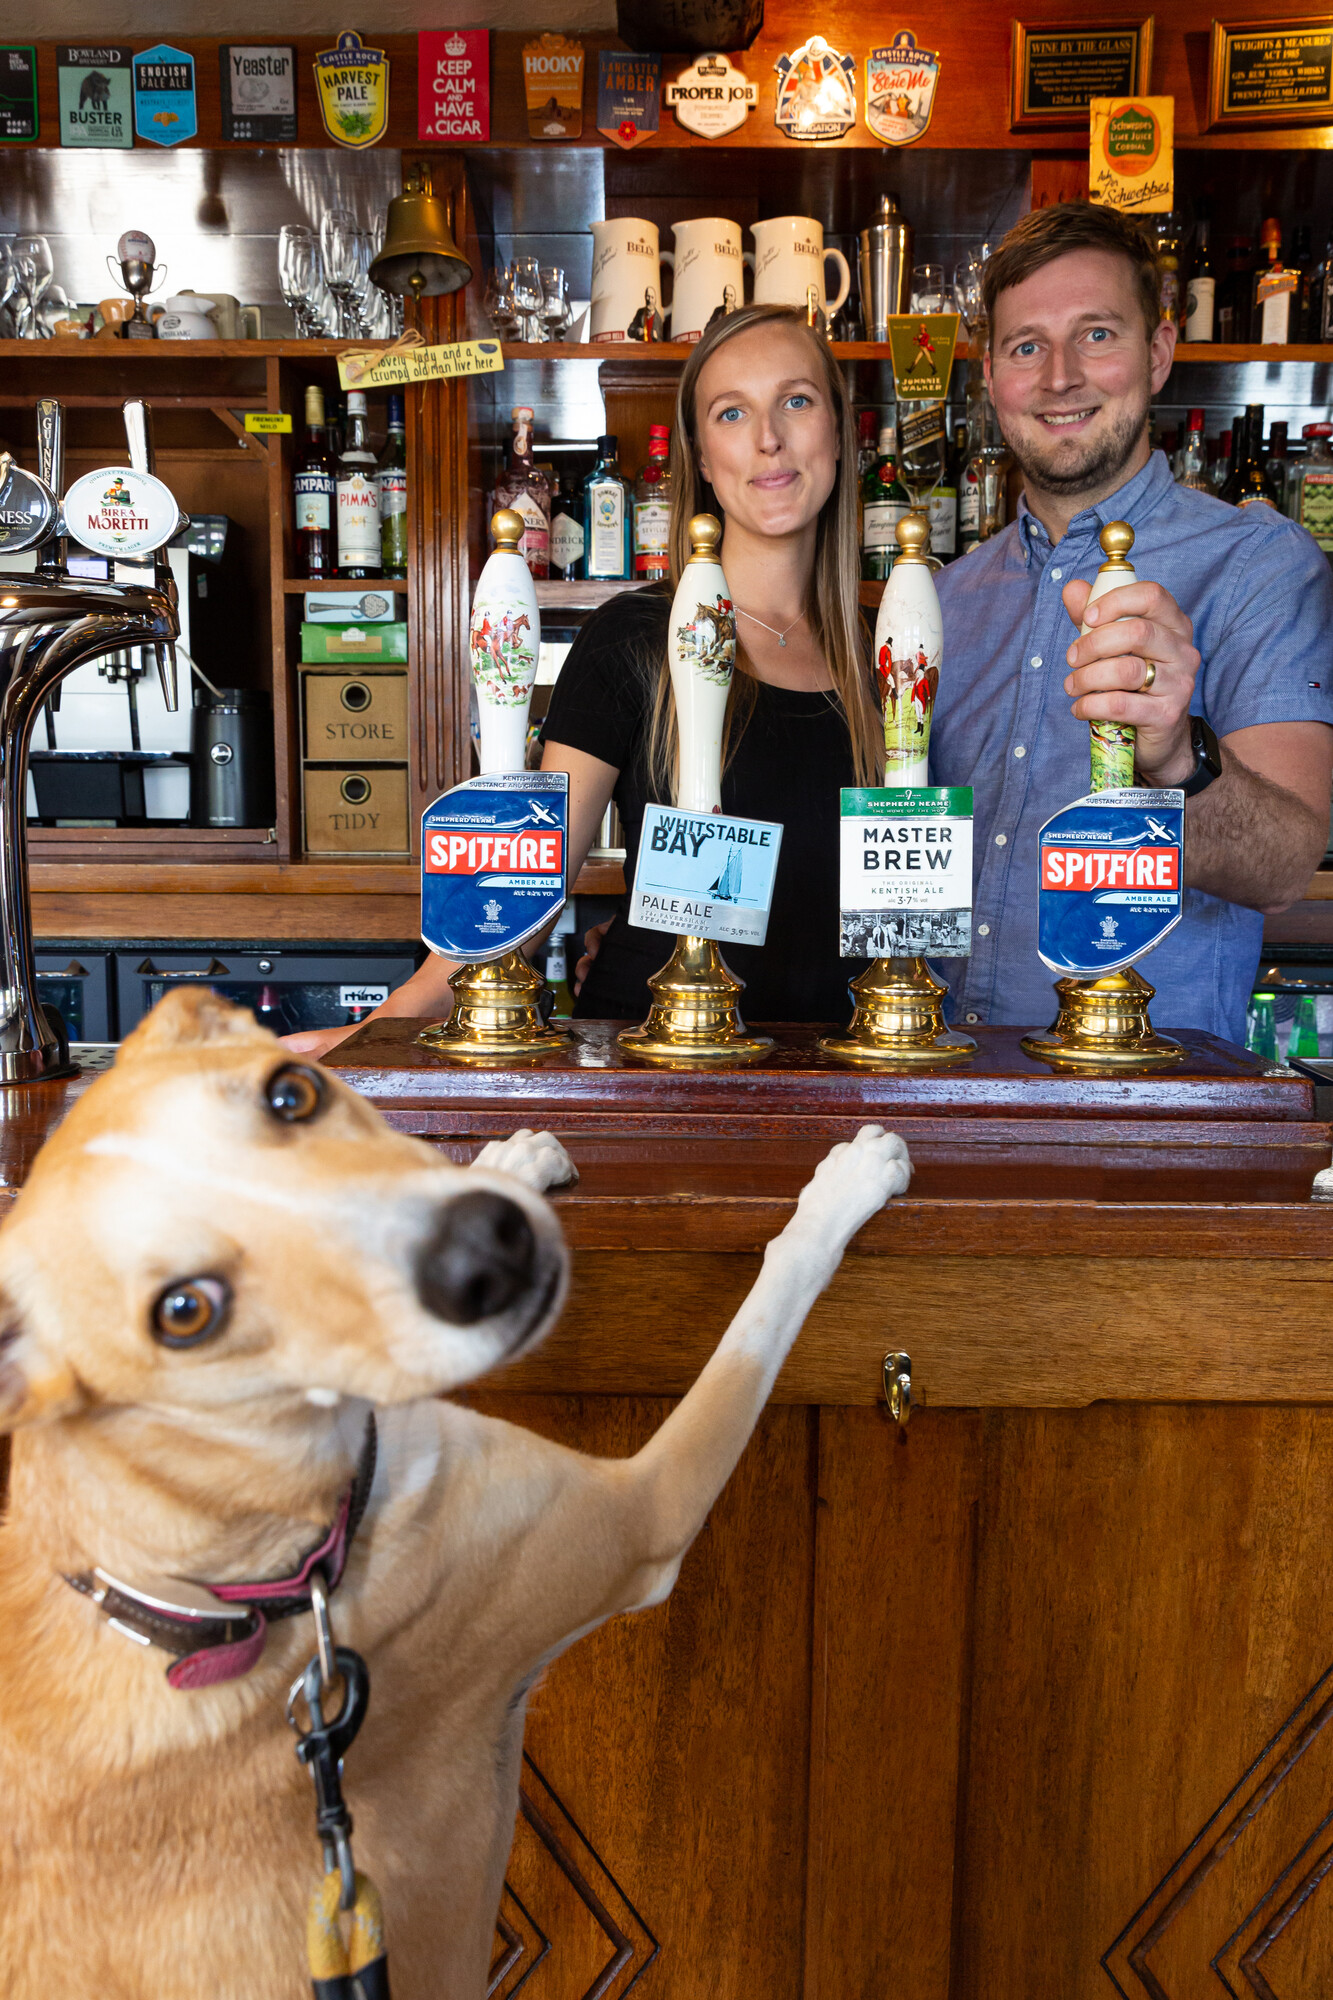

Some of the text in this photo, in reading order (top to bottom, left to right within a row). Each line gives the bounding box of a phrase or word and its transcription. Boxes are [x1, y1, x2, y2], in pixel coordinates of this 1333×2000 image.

[1031, 39, 1131, 54] WINE BY THE GLASS
[68, 48, 121, 63] BOWLAND
[323, 51, 378, 64] CASTLE ROCK
[875, 50, 931, 63] CASTLE ROCK
[1263, 50, 1281, 60] ACT
[140, 66, 187, 77] ENGLISH
[233, 55, 290, 77] Yeaster
[437, 59, 473, 76] KEEP
[525, 56, 582, 74] HOOKY
[601, 61, 659, 74] LANCASTER
[140, 77, 188, 88] PALE ALE
[323, 70, 380, 88] HARVEST
[432, 78, 476, 94] CALM
[606, 73, 655, 92] AMBER
[337, 85, 368, 101] PALE
[447, 94, 463, 102] AND
[671, 87, 754, 103] PROPER JOB
[435, 101, 474, 117] HAVE
[69, 111, 122, 125] BUSTER
[425, 120, 482, 135] A CIGAR
[791, 122, 841, 133] NAVIGATION
[1103, 181, 1170, 205] Schweppes
[413, 348, 437, 363] lady
[443, 344, 461, 359] and
[466, 347, 472, 357] a
[370, 355, 494, 382] Grumpy old man live here
[42, 418, 53, 486] GUINNES
[294, 478, 334, 493] AMPARI
[381, 477, 406, 489] NZAN
[340, 490, 377, 508] PIMM'S
[101, 507, 136, 517] BIRRA
[88, 514, 149, 530] MORETTI
[549, 536, 584, 545] NDRICK
[326, 723, 395, 740] STORE
[329, 813, 381, 831] TIDY
[431, 815, 496, 824] SHEPHERD NEAME
[659, 814, 772, 847] WHITSTABLE
[863, 827, 953, 843] MASTER
[1048, 832, 1113, 841] SHEPHERD NEAME
[650, 826, 708, 858] BAY
[430, 834, 557, 874] SPITFIRE
[863, 849, 953, 870] BREW
[1046, 851, 1173, 890] SPITFIRE
[871, 887, 919, 895] KENTISH
[641, 895, 714, 919] PALE ALE
[640, 915, 710, 932] STEAM BREWERY
[660, 912, 706, 926] FAVERSHAM
[344, 989, 383, 1001] rhino
